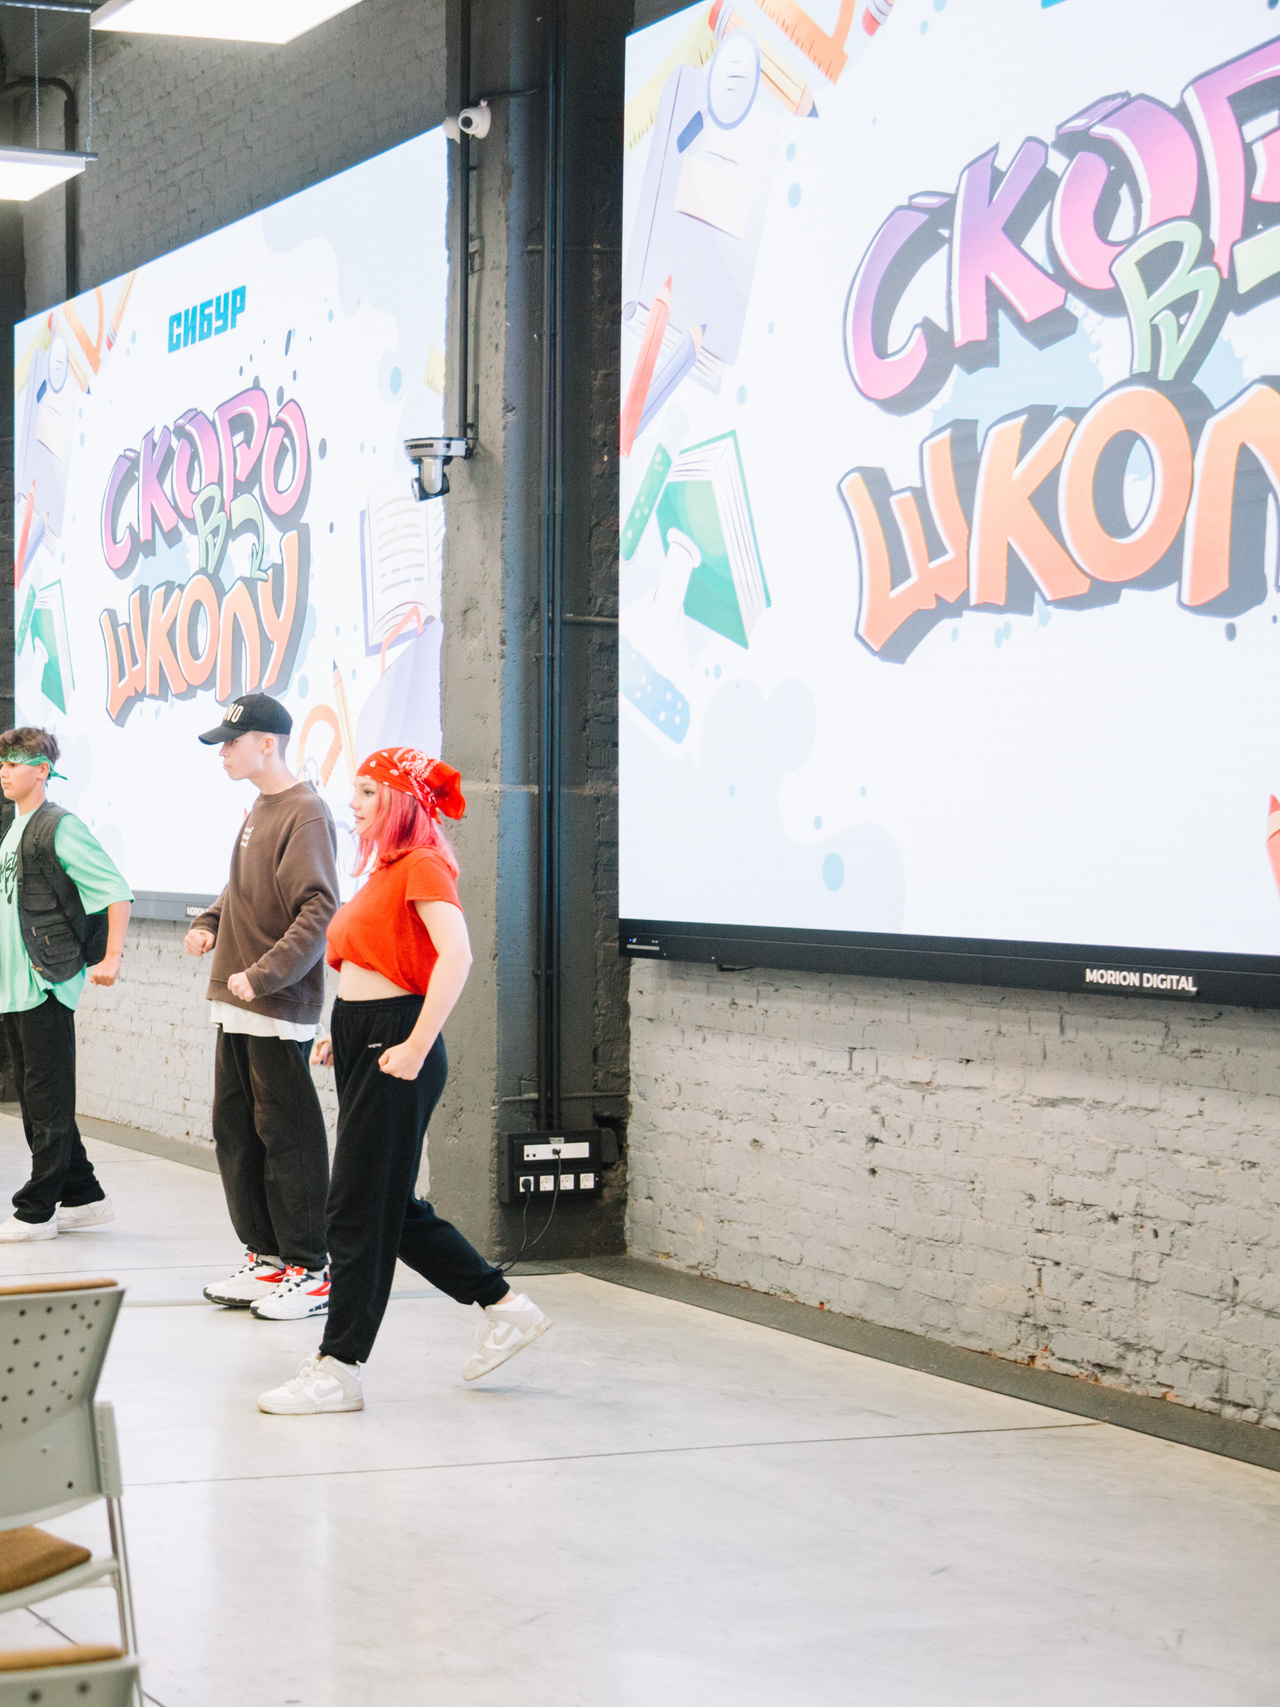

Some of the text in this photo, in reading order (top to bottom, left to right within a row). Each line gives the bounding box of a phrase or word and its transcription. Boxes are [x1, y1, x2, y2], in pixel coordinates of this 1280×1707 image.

[167, 284, 246, 353] СИБУР
[101, 387, 310, 571] СКОРО
[100, 530, 304, 722] ШКОЛУ
[1085, 968, 1198, 992] MORION DIGITAL
